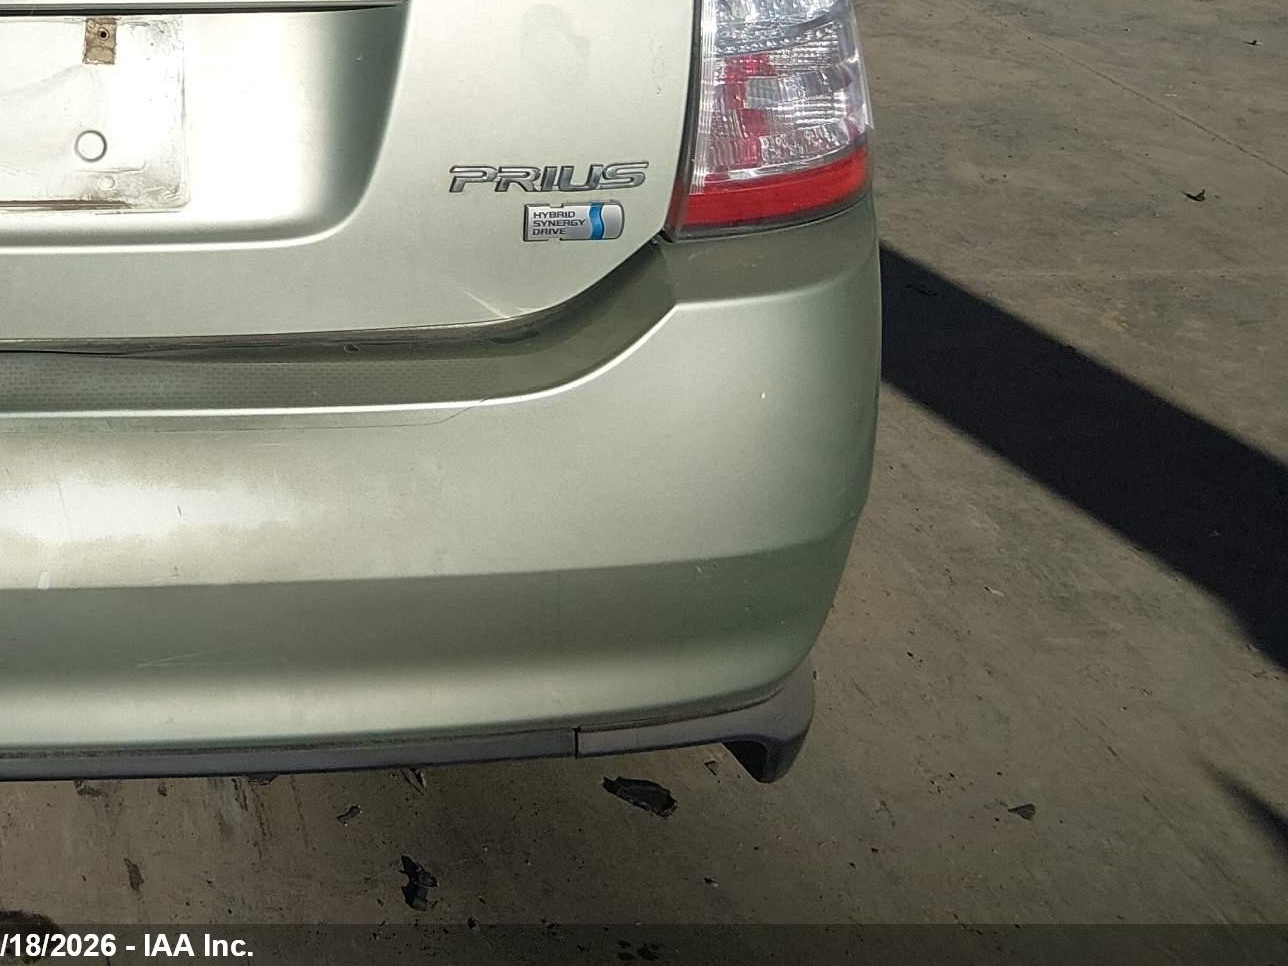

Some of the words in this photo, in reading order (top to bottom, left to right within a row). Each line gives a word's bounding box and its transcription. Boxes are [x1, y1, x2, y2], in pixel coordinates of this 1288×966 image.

[448, 161, 650, 193] PRIUS
[533, 210, 576, 219] HYBRID
[532, 218, 586, 227] SYNERGY
[532, 227, 567, 236] DRIVE
